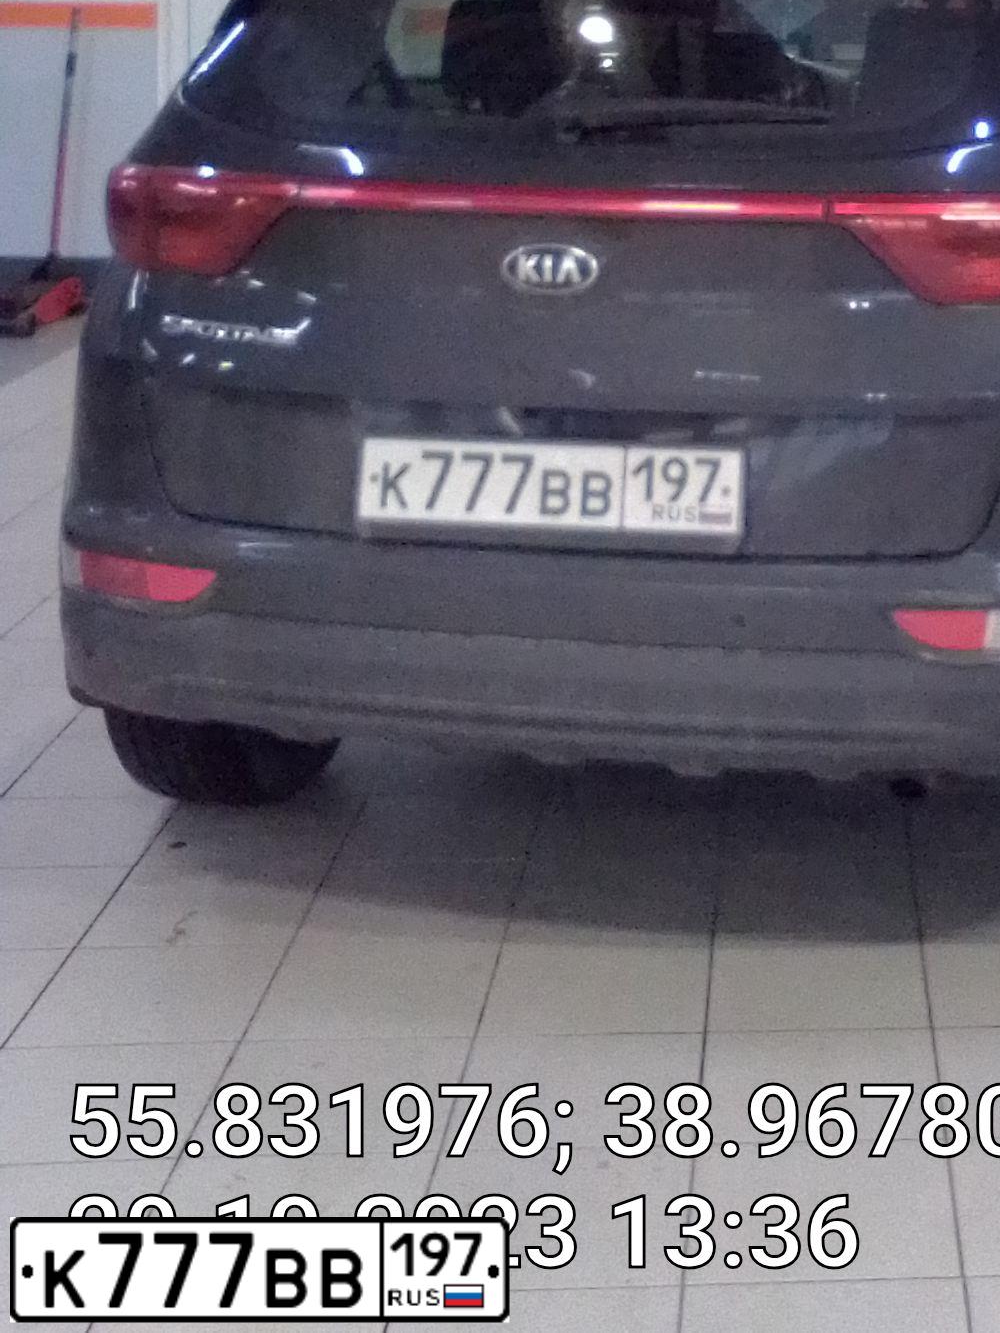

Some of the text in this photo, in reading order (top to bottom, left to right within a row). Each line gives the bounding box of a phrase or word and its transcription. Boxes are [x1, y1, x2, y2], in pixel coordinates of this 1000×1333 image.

[518, 253, 582, 283] KIA
[633, 455, 721, 503] 197
[653, 504, 696, 524] RUS
